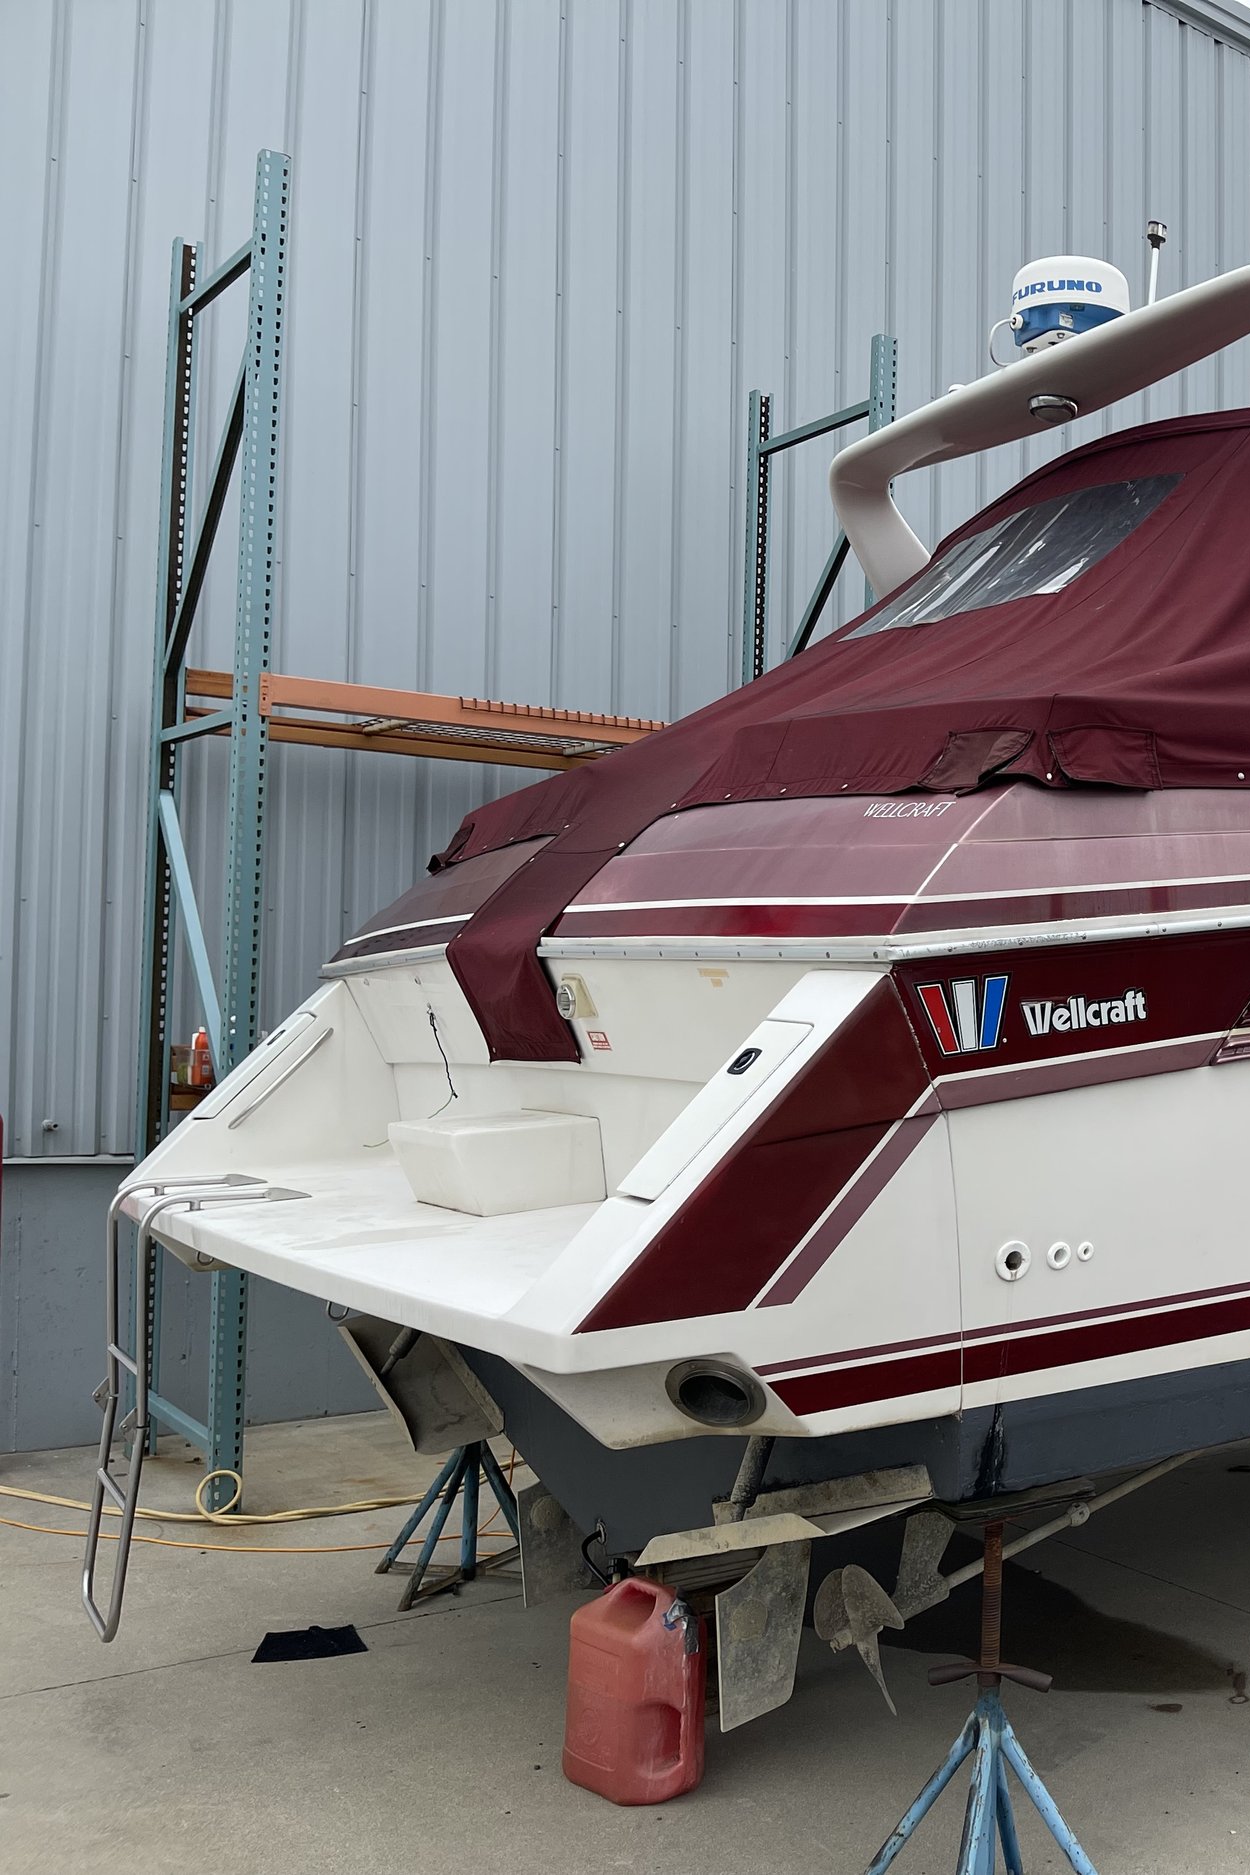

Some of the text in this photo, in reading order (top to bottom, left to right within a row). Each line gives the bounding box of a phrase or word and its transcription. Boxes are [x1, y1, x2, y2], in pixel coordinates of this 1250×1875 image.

[1012, 279, 1102, 304] FURUNO
[863, 801, 956, 818] WELLCRAFT
[1021, 988, 1147, 1036] Wellcraft
